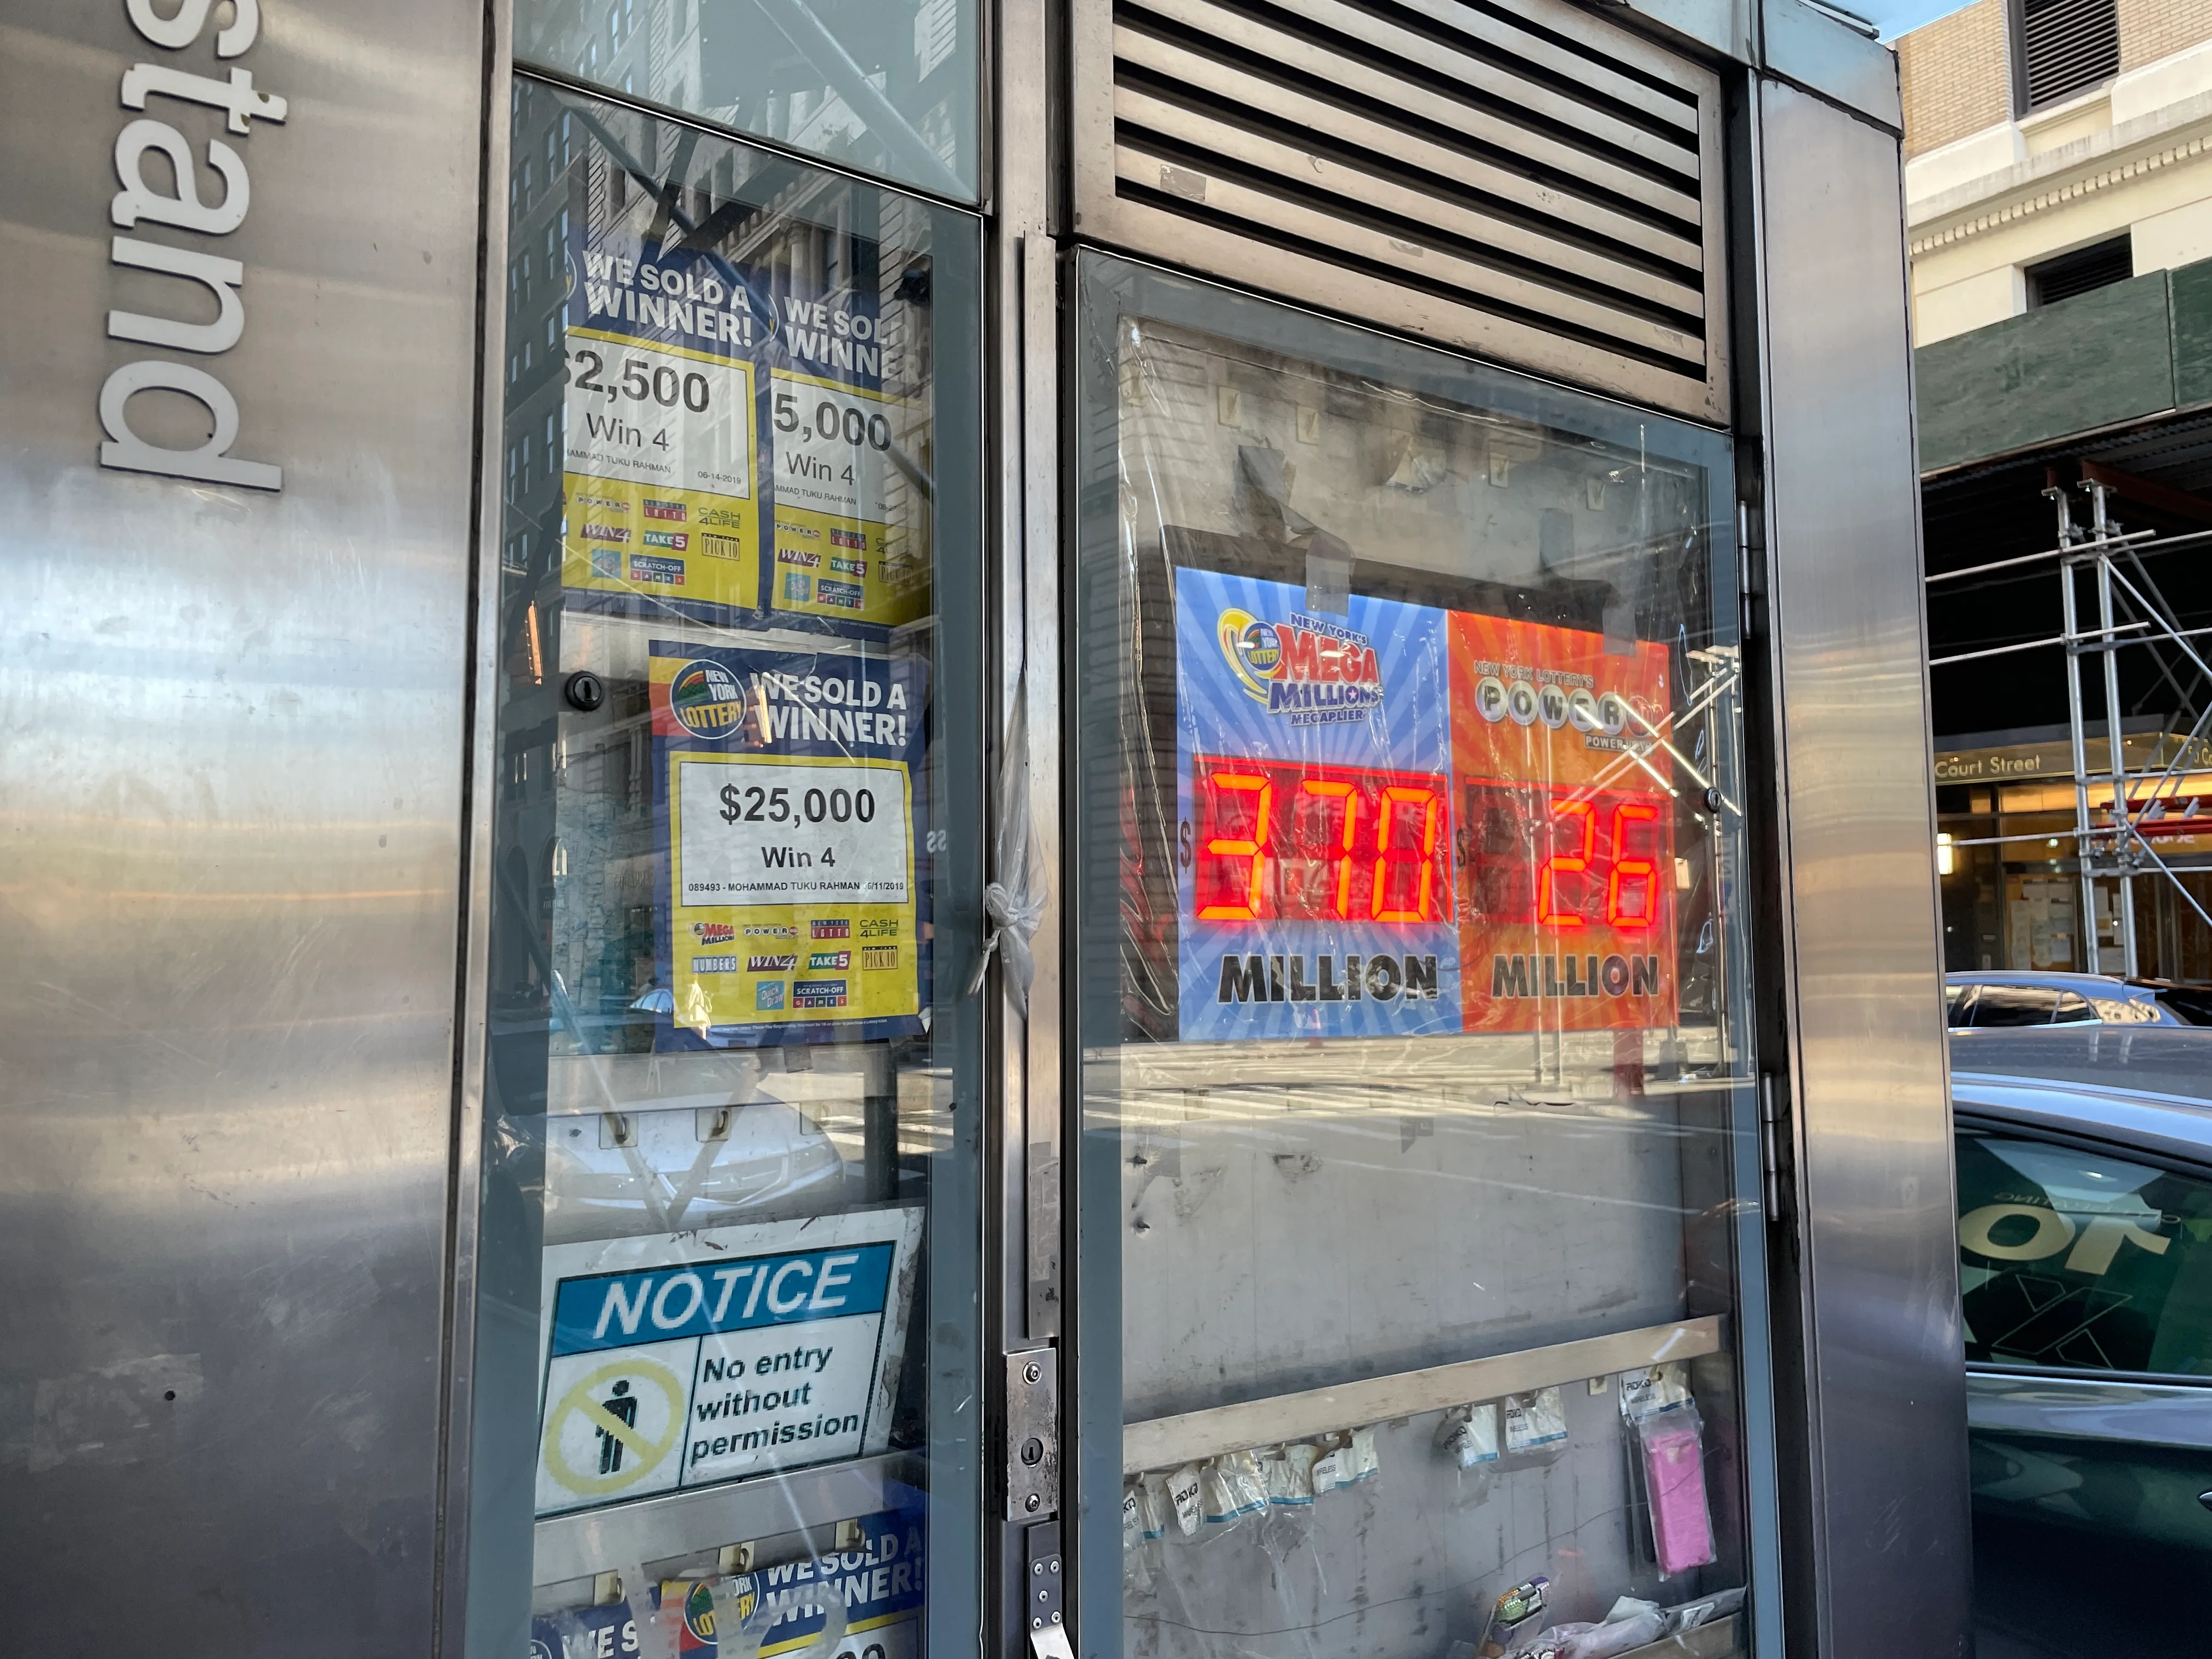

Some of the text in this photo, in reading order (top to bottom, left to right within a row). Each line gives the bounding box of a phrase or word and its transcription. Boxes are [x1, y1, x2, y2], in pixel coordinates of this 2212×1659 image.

[582, 250, 634, 286] WE
[640, 264, 724, 304] SOLD
[730, 285, 752, 313] A
[584, 281, 752, 347] WINNER!
[784, 296, 828, 330] WE
[833, 310, 909, 347] SOLD
[586, 412, 669, 452] Win 4
[606, 456, 630, 467] TUKU
[633, 460, 671, 473] RAHMAN
[786, 452, 856, 486] Win 4
[697, 471, 742, 485] 06-14-2019
[802, 489, 822, 499] TUKU
[824, 493, 857, 505] RAHMAN
[644, 508, 686, 521] LOTTO
[698, 507, 741, 521] CASH
[699, 517, 741, 529] 4LIFE
[704, 542, 738, 558] PICK 10
[633, 560, 682, 572] SCRATCH-OFF
[821, 585, 861, 596] SCRATCH-OFF
[1290, 613, 1367, 645] NEW YORK'S
[1273, 624, 1380, 684] MEGA
[705, 669, 729, 684] NEW
[1474, 661, 1595, 689] NEW YORK LOTTERY'S
[708, 683, 738, 701] YORK
[749, 672, 907, 710] WE SOLD A
[1269, 681, 1380, 712] MILLIONS
[680, 701, 742, 729] LOTTERY
[755, 704, 907, 747] WINNER!
[1291, 709, 1363, 726] MEGAPLIER
[1934, 755, 2041, 778] Court Street
[719, 783, 876, 829] $25,000
[1180, 816, 1192, 874] $
[1197, 772, 1437, 923] 370
[761, 846, 836, 868] Win 4
[688, 883, 721, 891] 089493
[728, 882, 788, 891] MOHAMMAD
[790, 882, 817, 890] TUKU
[819, 881, 860, 890] RAHMAN
[864, 881, 904, 891] 6/11/2019
[704, 923, 735, 937] MEGA
[744, 927, 789, 936] POWER
[812, 928, 849, 938] LOTTO
[860, 919, 899, 927] CASH
[860, 929, 898, 939] 4LIFE
[693, 956, 736, 972] NUMBERS
[865, 951, 896, 968] PICK 10
[1217, 953, 1438, 1005] MILLION
[1491, 953, 1659, 998] MILLION
[761, 985, 780, 1001] Quick
[766, 992, 785, 1008] Draw
[797, 986, 844, 995] SCRATCH-OFF
[592, 1252, 860, 1341] NOTICE
[702, 1346, 833, 1384] No entry
[696, 1381, 812, 1423] without
[690, 1413, 859, 1468] permission
[768, 1562, 814, 1587] WE
[820, 1533, 899, 1575] SOLD
